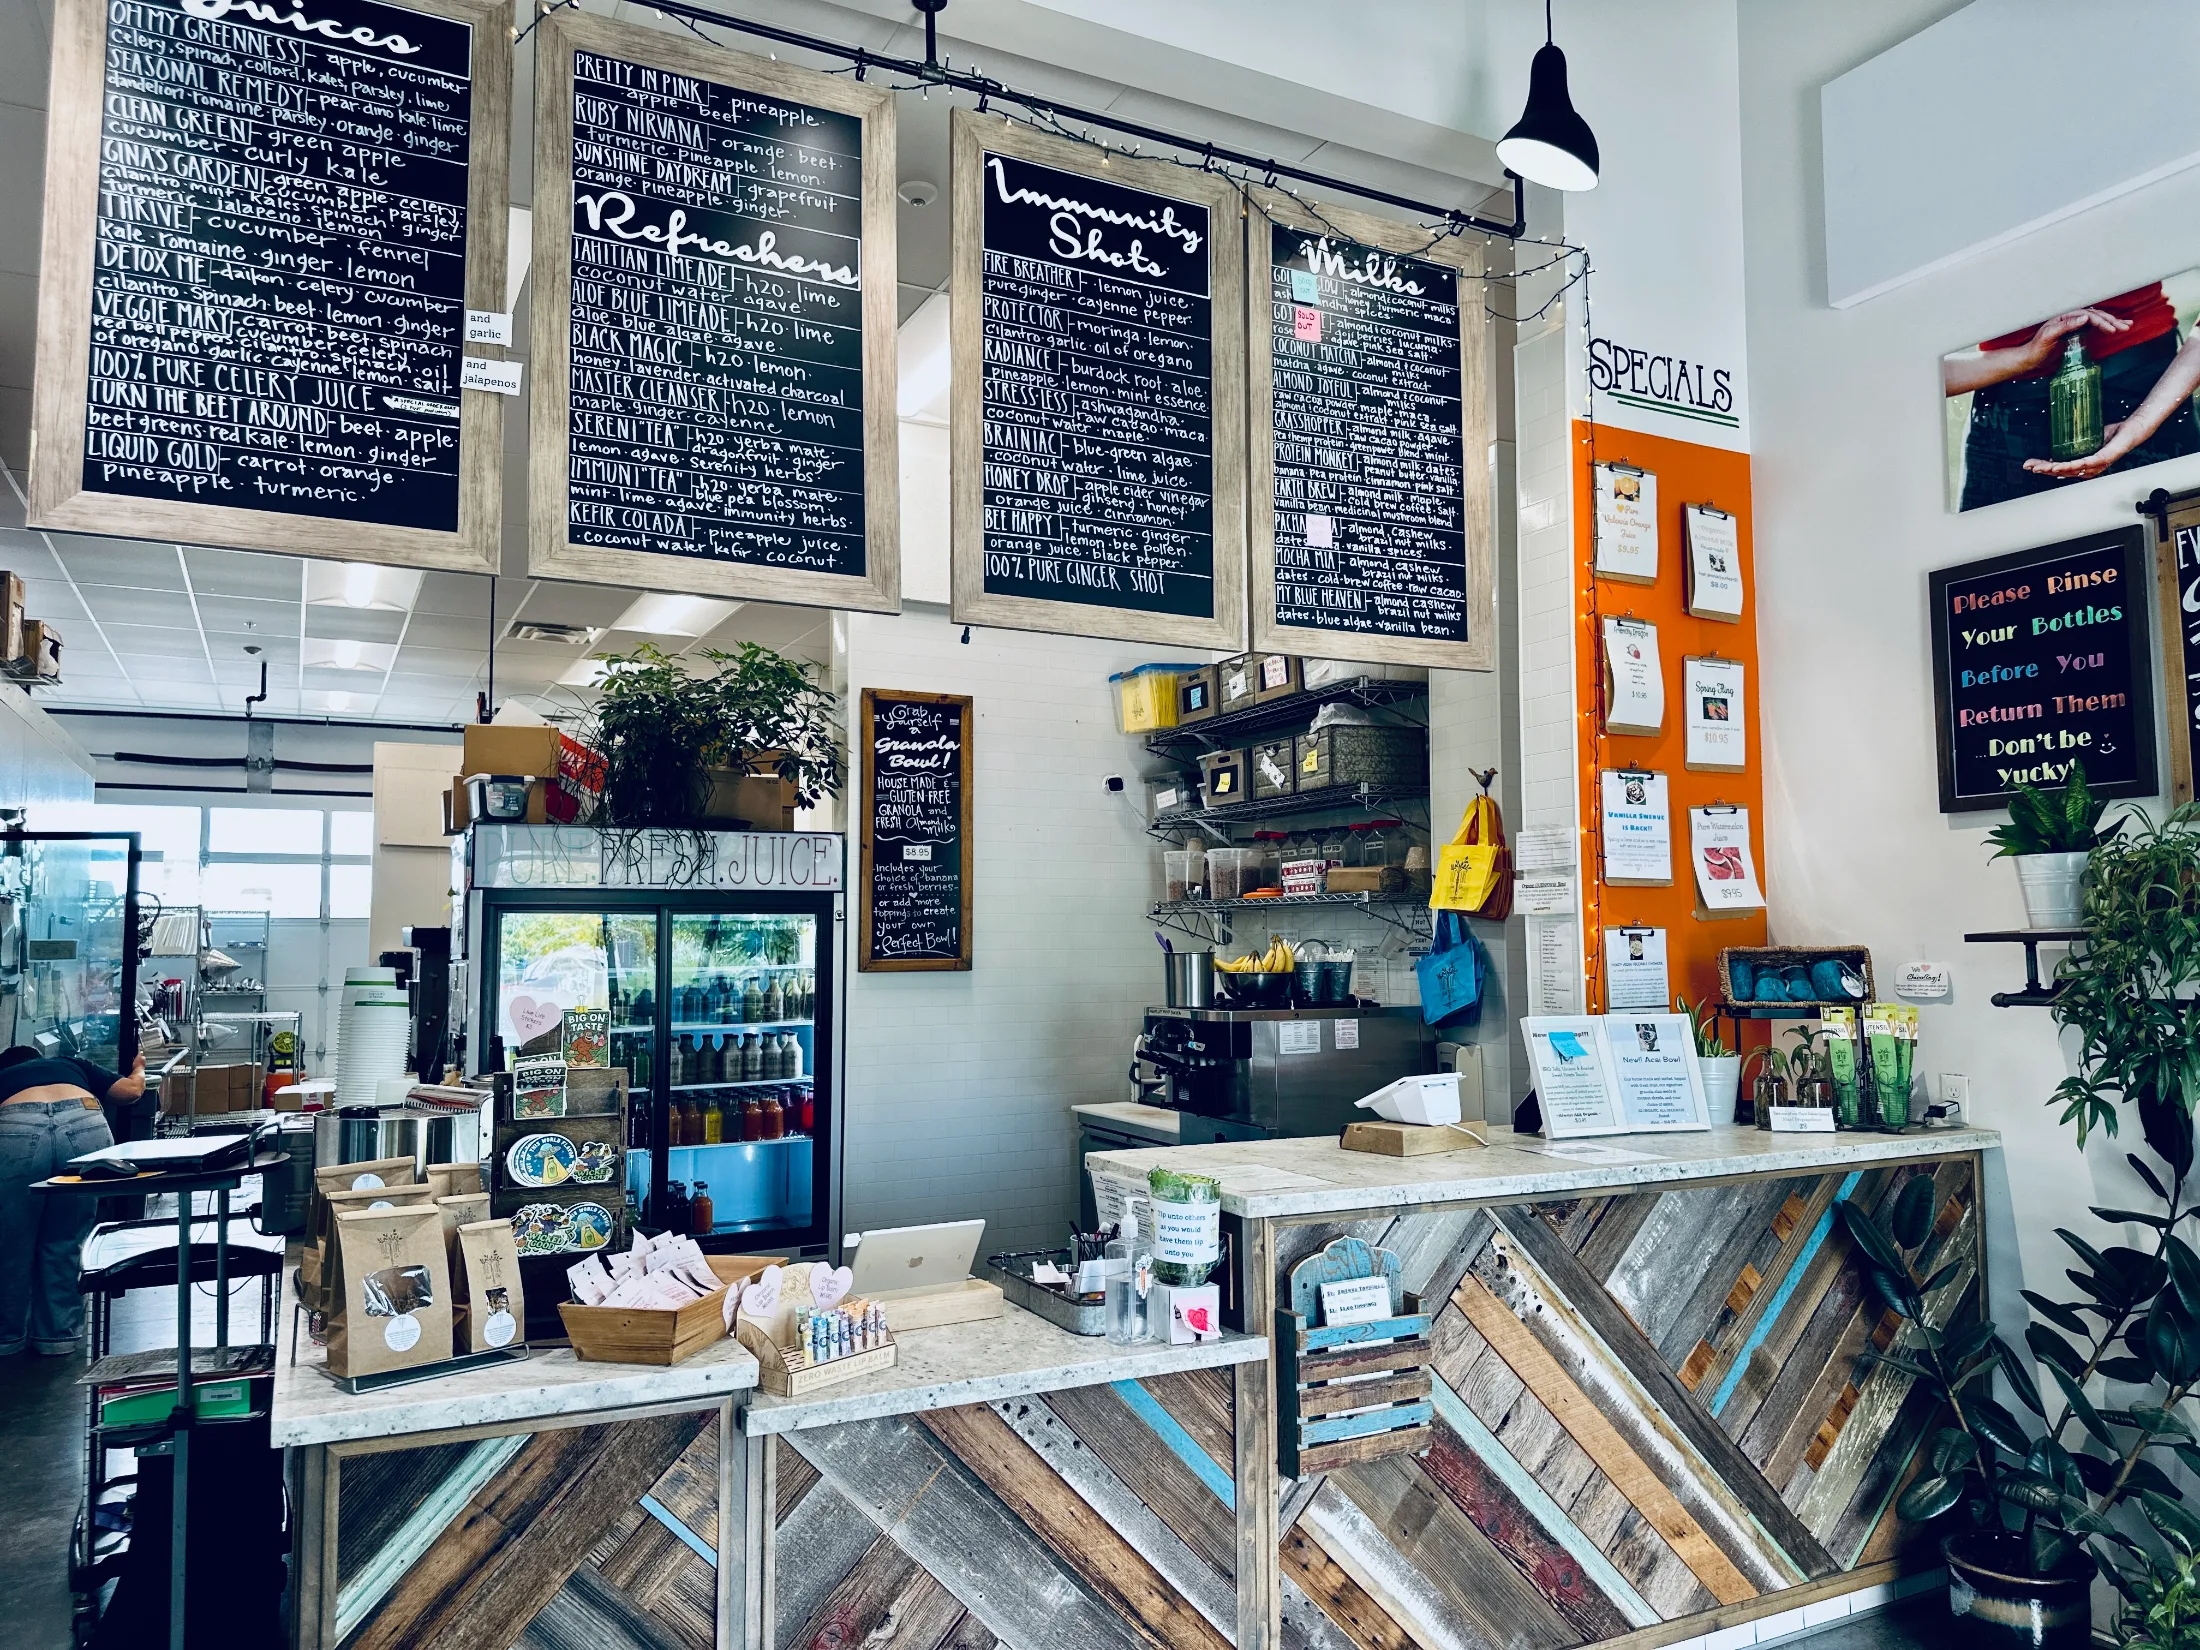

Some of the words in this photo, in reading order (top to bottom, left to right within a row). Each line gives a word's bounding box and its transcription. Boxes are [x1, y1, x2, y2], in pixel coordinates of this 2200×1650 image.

[111, 2, 142, 28] OH
[148, 8, 179, 35] MY
[184, 17, 300, 64] GREENNESS
[108, 48, 208, 90] SEASONAL
[218, 70, 304, 111] REMEDY
[576, 53, 633, 86] PRETTY
[641, 69, 657, 91] IN
[663, 74, 702, 104] PINK
[108, 95, 166, 127] CLEAN
[176, 108, 245, 142] GREEN
[268, 129, 333, 152] green
[341, 144, 406, 167] apple
[575, 94, 619, 129] RUBY
[627, 107, 703, 150] NIRVANA
[987, 158, 1203, 254] Immunity
[575, 192, 859, 284] Refreshers
[1049, 211, 1168, 277] Shots
[101, 240, 170, 278] DETOX
[177, 254, 207, 283] ME
[983, 252, 1009, 275] FIRE
[1013, 258, 1074, 288] BREATHER
[1299, 236, 1426, 295] Milks
[97, 290, 170, 324] VEGGIE
[177, 302, 230, 334] MARY
[469, 313, 491, 324] and
[984, 296, 1063, 332] PROTECTOR
[1297, 310, 1315, 321] SOLD
[469, 328, 501, 339] garlic
[1297, 322, 1313, 331] OUT
[573, 323, 624, 355] BLACK
[630, 333, 682, 364] MAGIC
[1272, 336, 1317, 359] COCONUT
[1320, 344, 1358, 367] MATCHA
[465, 359, 487, 370] and
[984, 338, 1052, 371] RADIANCE
[92, 346, 146, 380] 100%
[153, 356, 206, 388] PURE
[214, 363, 299, 403] CELERY
[311, 379, 375, 411] JUICE
[462, 373, 517, 389] jalapenos
[1590, 337, 1732, 412] SPECIALS
[1274, 410, 1343, 436] GRASSHOPPER
[984, 421, 1056, 455] BRAINIAC
[88, 430, 159, 463] LIQUID
[167, 441, 217, 472] GOLD
[103, 462, 234, 493] pineapple
[570, 502, 616, 527] KEFIR
[622, 509, 687, 537] COLADA
[1624, 505, 1639, 515] Pure
[1620, 528, 1636, 540] Juice
[1629, 518, 1651, 532] Orange
[1275, 547, 1310, 567] MOCHA
[1315, 551, 1335, 570] MIA
[1617, 544, 1639, 555] $9.95
[985, 552, 1024, 579] 100%
[1028, 557, 1063, 583] PURE
[1066, 560, 1121, 591] GINGER
[1130, 569, 1165, 595] SHOT
[1276, 584, 1291, 603] MY
[1295, 587, 1318, 606] BLUE
[1322, 589, 1361, 609] HEAVEN
[1953, 585, 2031, 614] Please
[2047, 567, 2118, 595] Rinse
[1961, 624, 2018, 649] Your
[2031, 604, 2123, 636] Bottles
[1961, 662, 2039, 688] Before
[2055, 652, 2104, 674] You
[1695, 680, 1716, 696] Spring
[1717, 682, 1734, 697] Fling
[891, 704, 928, 719] Grab
[1960, 702, 2043, 728] Return
[2051, 692, 2127, 714] Them
[909, 726, 921, 735] a
[1704, 732, 1728, 744] $10.95
[2059, 729, 2092, 749] be
[874, 734, 960, 754] Granola
[888, 751, 951, 769] Bowl!
[877, 776, 909, 790] HOUSE
[910, 776, 936, 790] MADE
[889, 789, 951, 804] GLUTEN-FREE
[878, 803, 924, 818] GRANOLA
[928, 805, 947, 816] and
[875, 816, 902, 830] FRESH
[1697, 822, 1710, 831] Pure
[1711, 822, 1744, 831] Watermelon
[1713, 834, 1728, 842] Juice
[728, 834, 838, 885] JUICE.
[905, 848, 930, 857] $8.95
[910, 873, 919, 885] of
[925, 873, 959, 882] banana
[919, 865, 943, 879] your
[889, 882, 914, 892] fresh
[1721, 888, 1743, 899] $9.95
[876, 922, 905, 937] your
[911, 921, 936, 930] own
[882, 933, 923, 955] Perfect
[568, 1014, 587, 1024] BIG
[589, 1013, 607, 1023] ON
[570, 1022, 603, 1032] TASTE
[529, 1139, 541, 1153] THIS
[541, 1136, 561, 1144] WORLD
[561, 1138, 575, 1159] FLAVOR
[1157, 1210, 1167, 1219] Tip
[528, 1232, 564, 1243] WICKED
[530, 1240, 555, 1250] GOOD
[1159, 1234, 1173, 1244] have
[1174, 1237, 1193, 1245] them
[1164, 1249, 1181, 1257] unto
[1181, 1251, 1194, 1259] you
[798, 1370, 821, 1384] ZERO
[823, 1363, 851, 1376] WASTE
[853, 1357, 866, 1368] LIP
[867, 1351, 890, 1363] BALM
